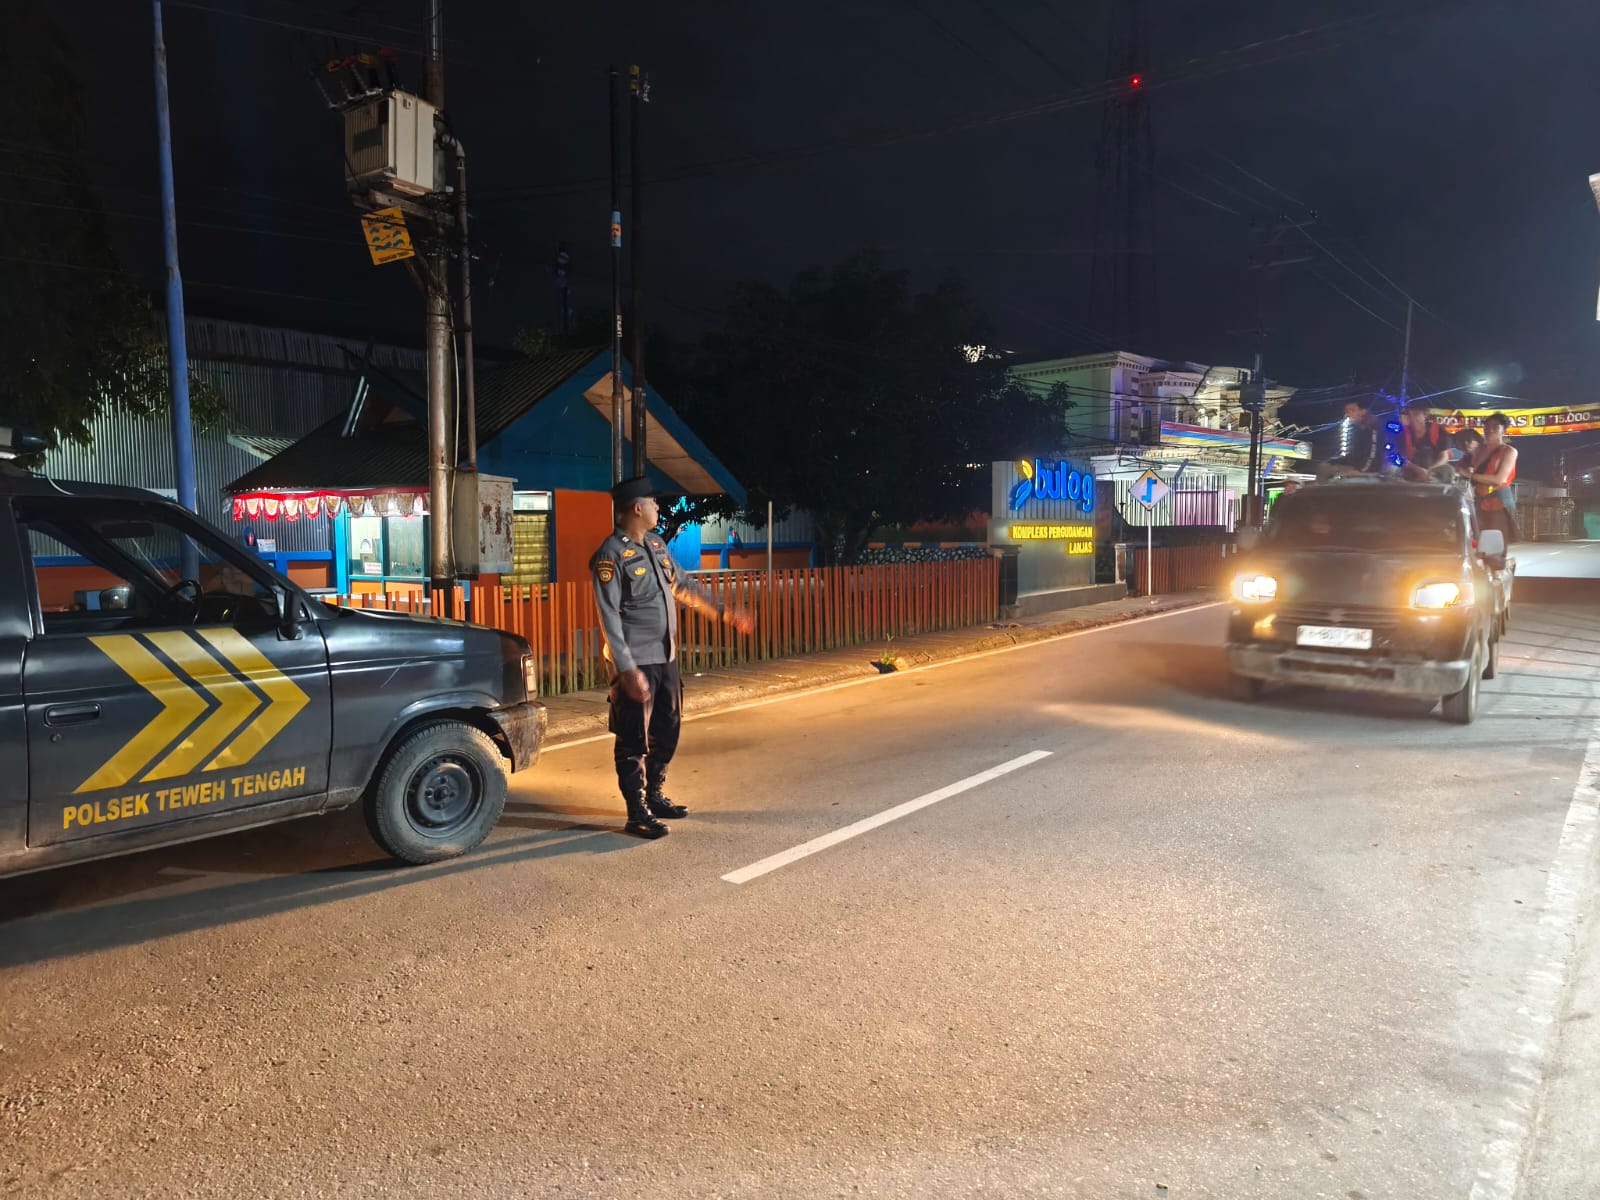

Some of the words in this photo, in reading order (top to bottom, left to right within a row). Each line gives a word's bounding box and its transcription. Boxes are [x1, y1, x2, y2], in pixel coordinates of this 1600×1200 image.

[1035, 459, 1094, 512] bulog
[1012, 525, 1048, 539] KOMPLEKS
[1048, 526, 1093, 538] PERGUDANGAN
[1068, 541, 1093, 554] LANJAS
[63, 792, 150, 829] POLSEK
[156, 782, 225, 812] TEWEH
[231, 766, 306, 797] TENGAH
